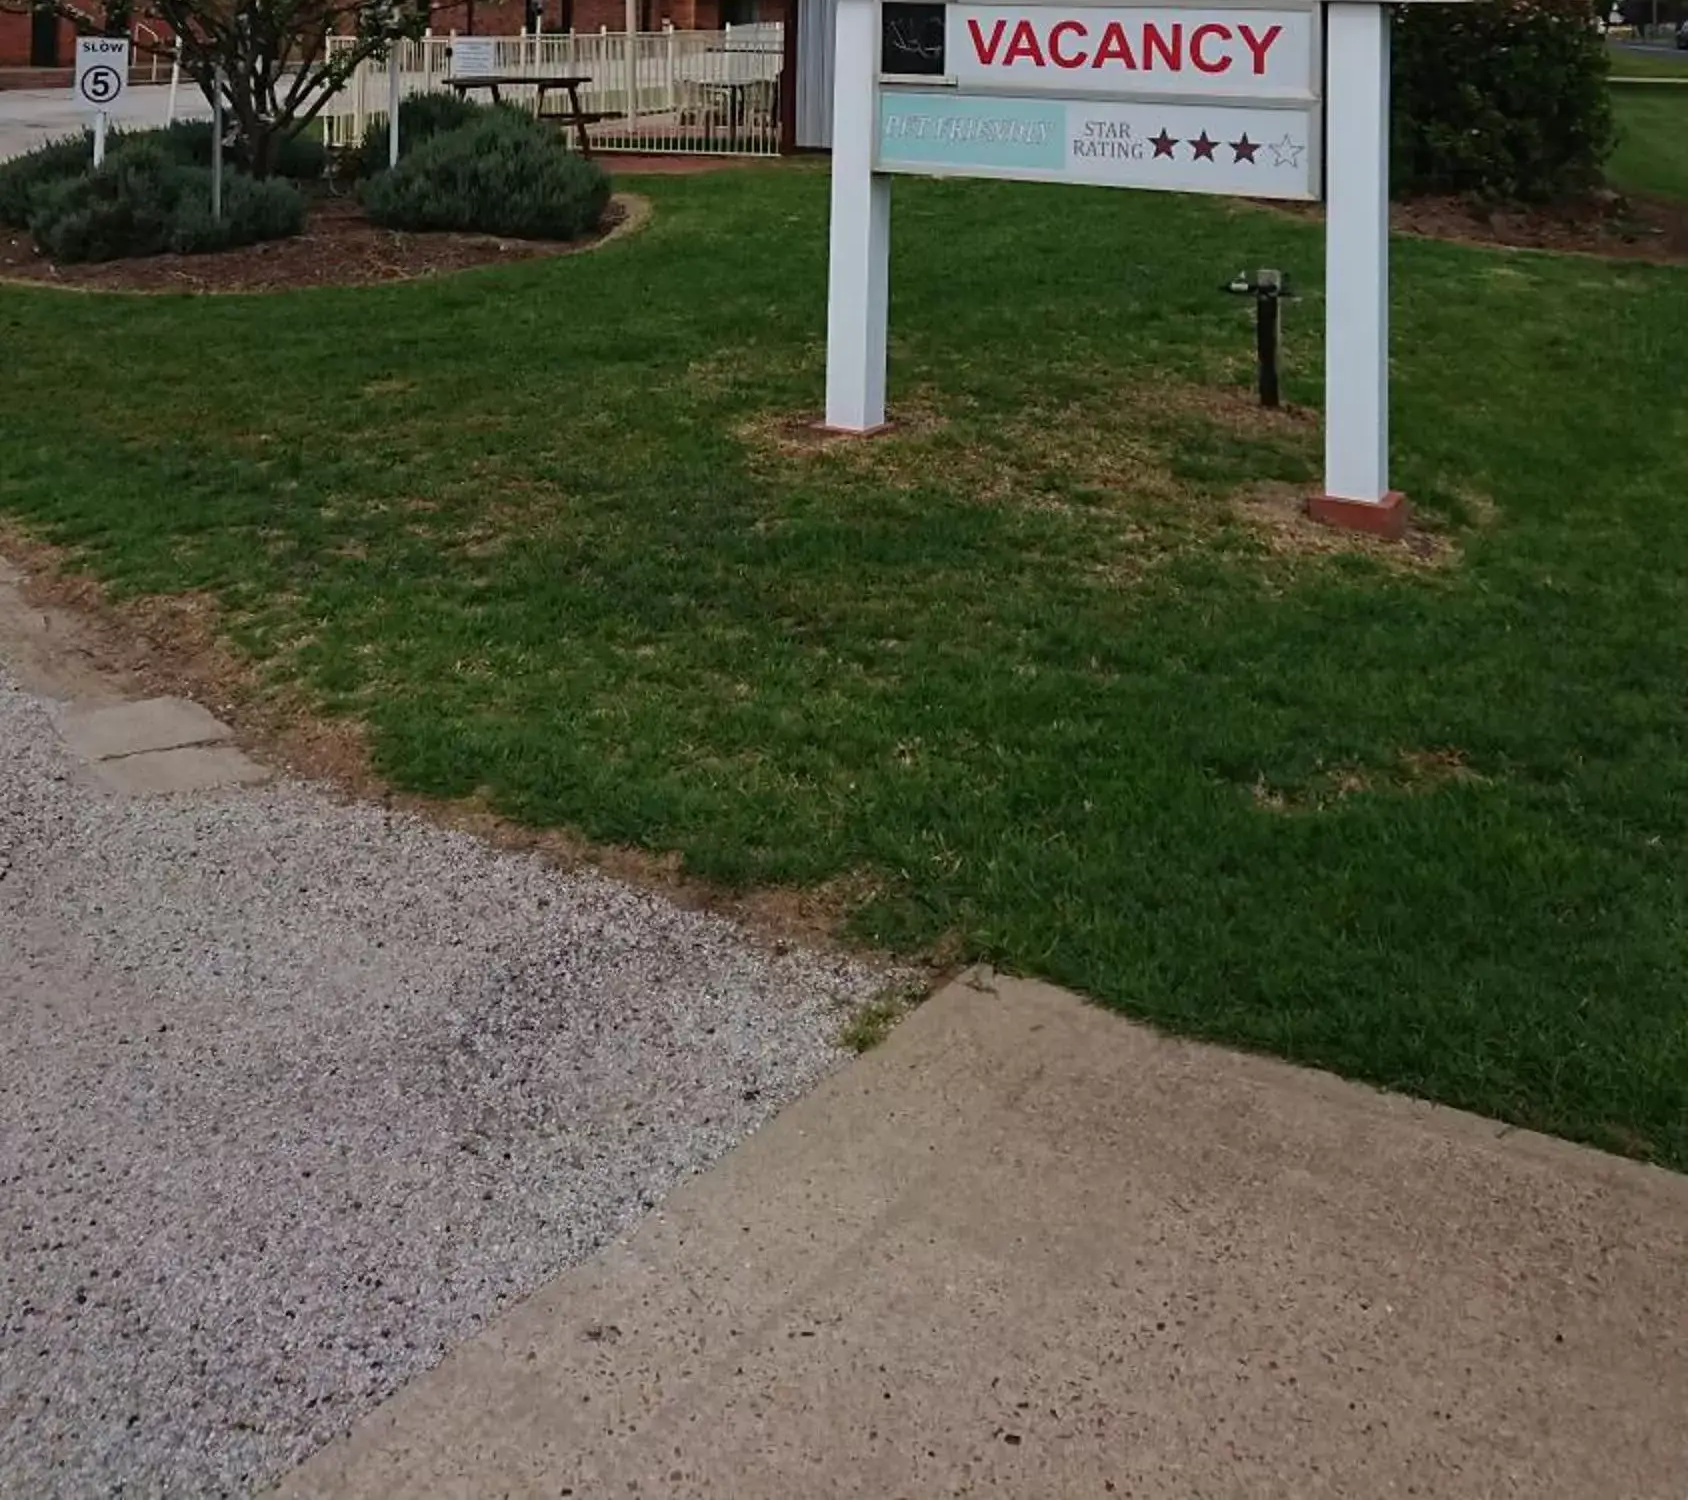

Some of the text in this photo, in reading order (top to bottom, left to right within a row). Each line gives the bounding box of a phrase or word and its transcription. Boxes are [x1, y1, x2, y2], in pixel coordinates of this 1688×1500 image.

[83, 42, 124, 52] SLOW
[967, 19, 1284, 74] VACANCY
[92, 72, 109, 96] 5
[1084, 120, 1131, 139] STAR
[1073, 139, 1143, 160] RATING
